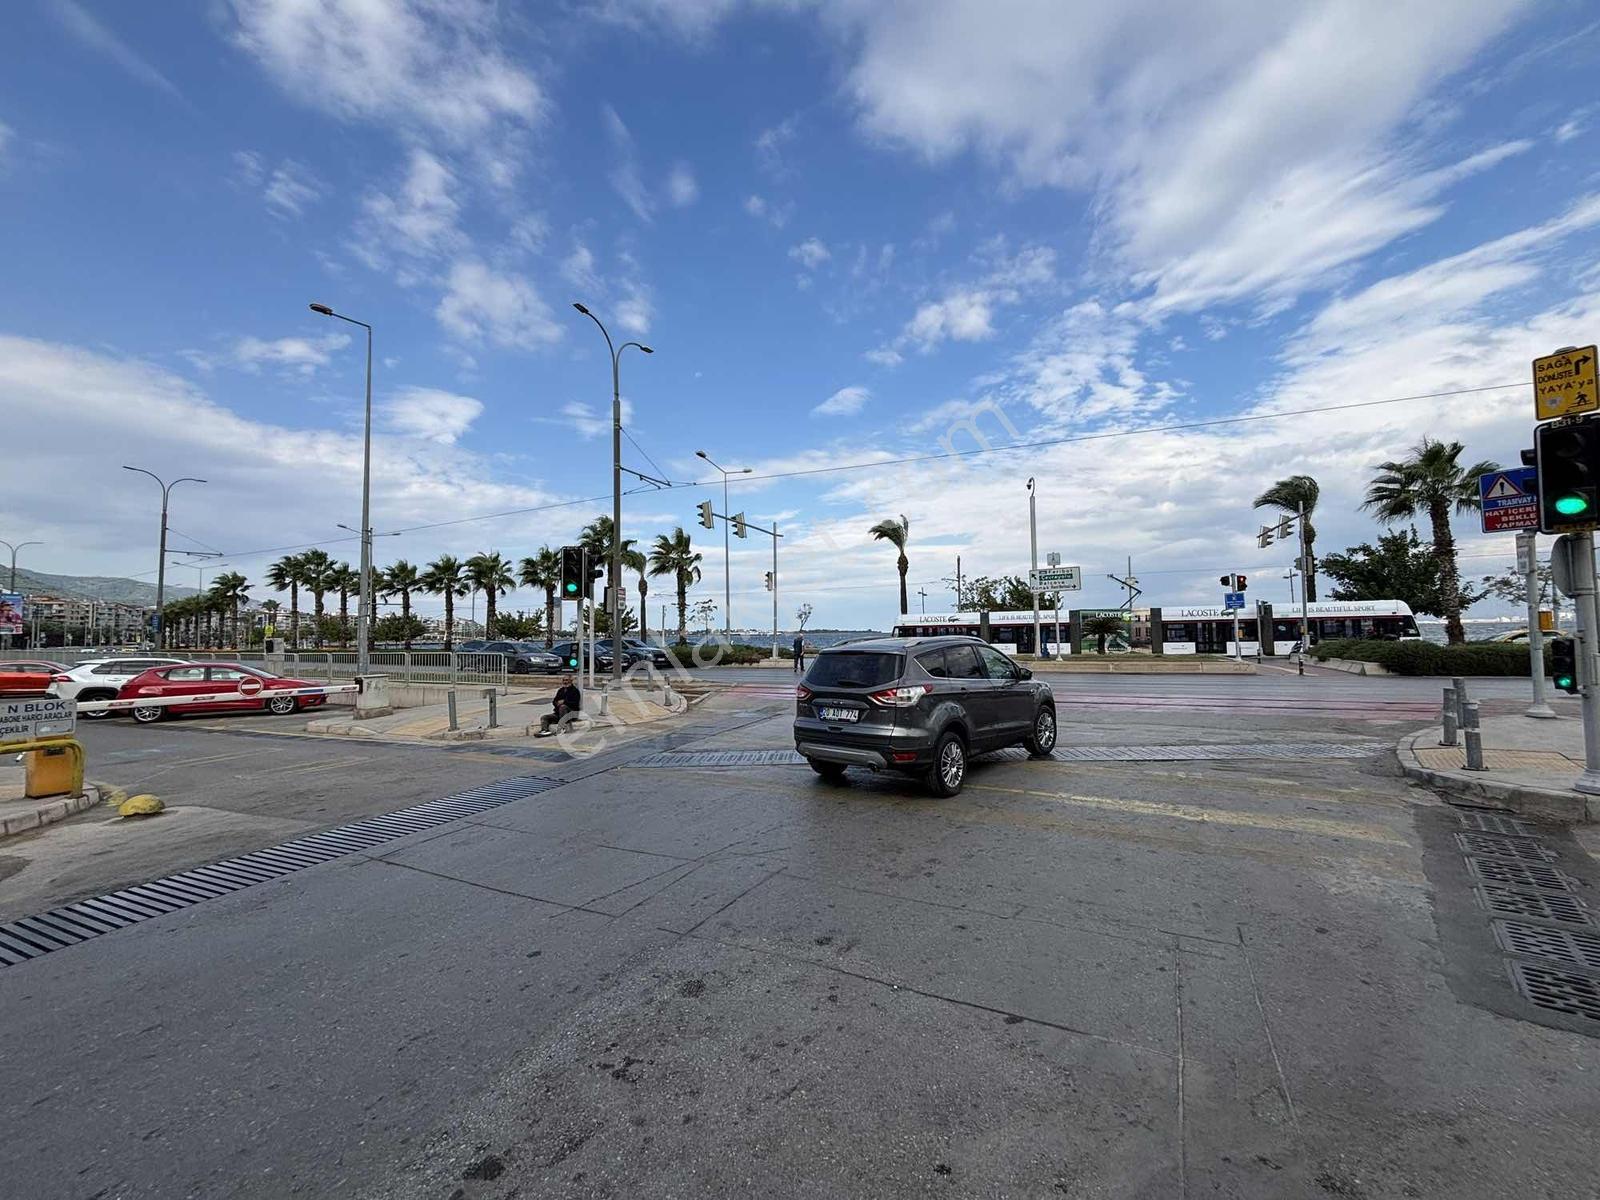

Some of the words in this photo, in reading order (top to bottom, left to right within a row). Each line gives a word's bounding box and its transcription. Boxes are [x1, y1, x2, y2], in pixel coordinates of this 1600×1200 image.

[1508, 505, 1537, 515] İÇERİ
[1501, 512, 1537, 522] BEKLE
[1495, 519, 1538, 529] YAPMAY
[1181, 609, 1219, 617] LACOSTE
[1315, 605, 1353, 613] BEAUTIFUL
[919, 615, 947, 623] LACOSTE
[8, 704, 18, 714] N
[24, 701, 66, 712] BLOK
